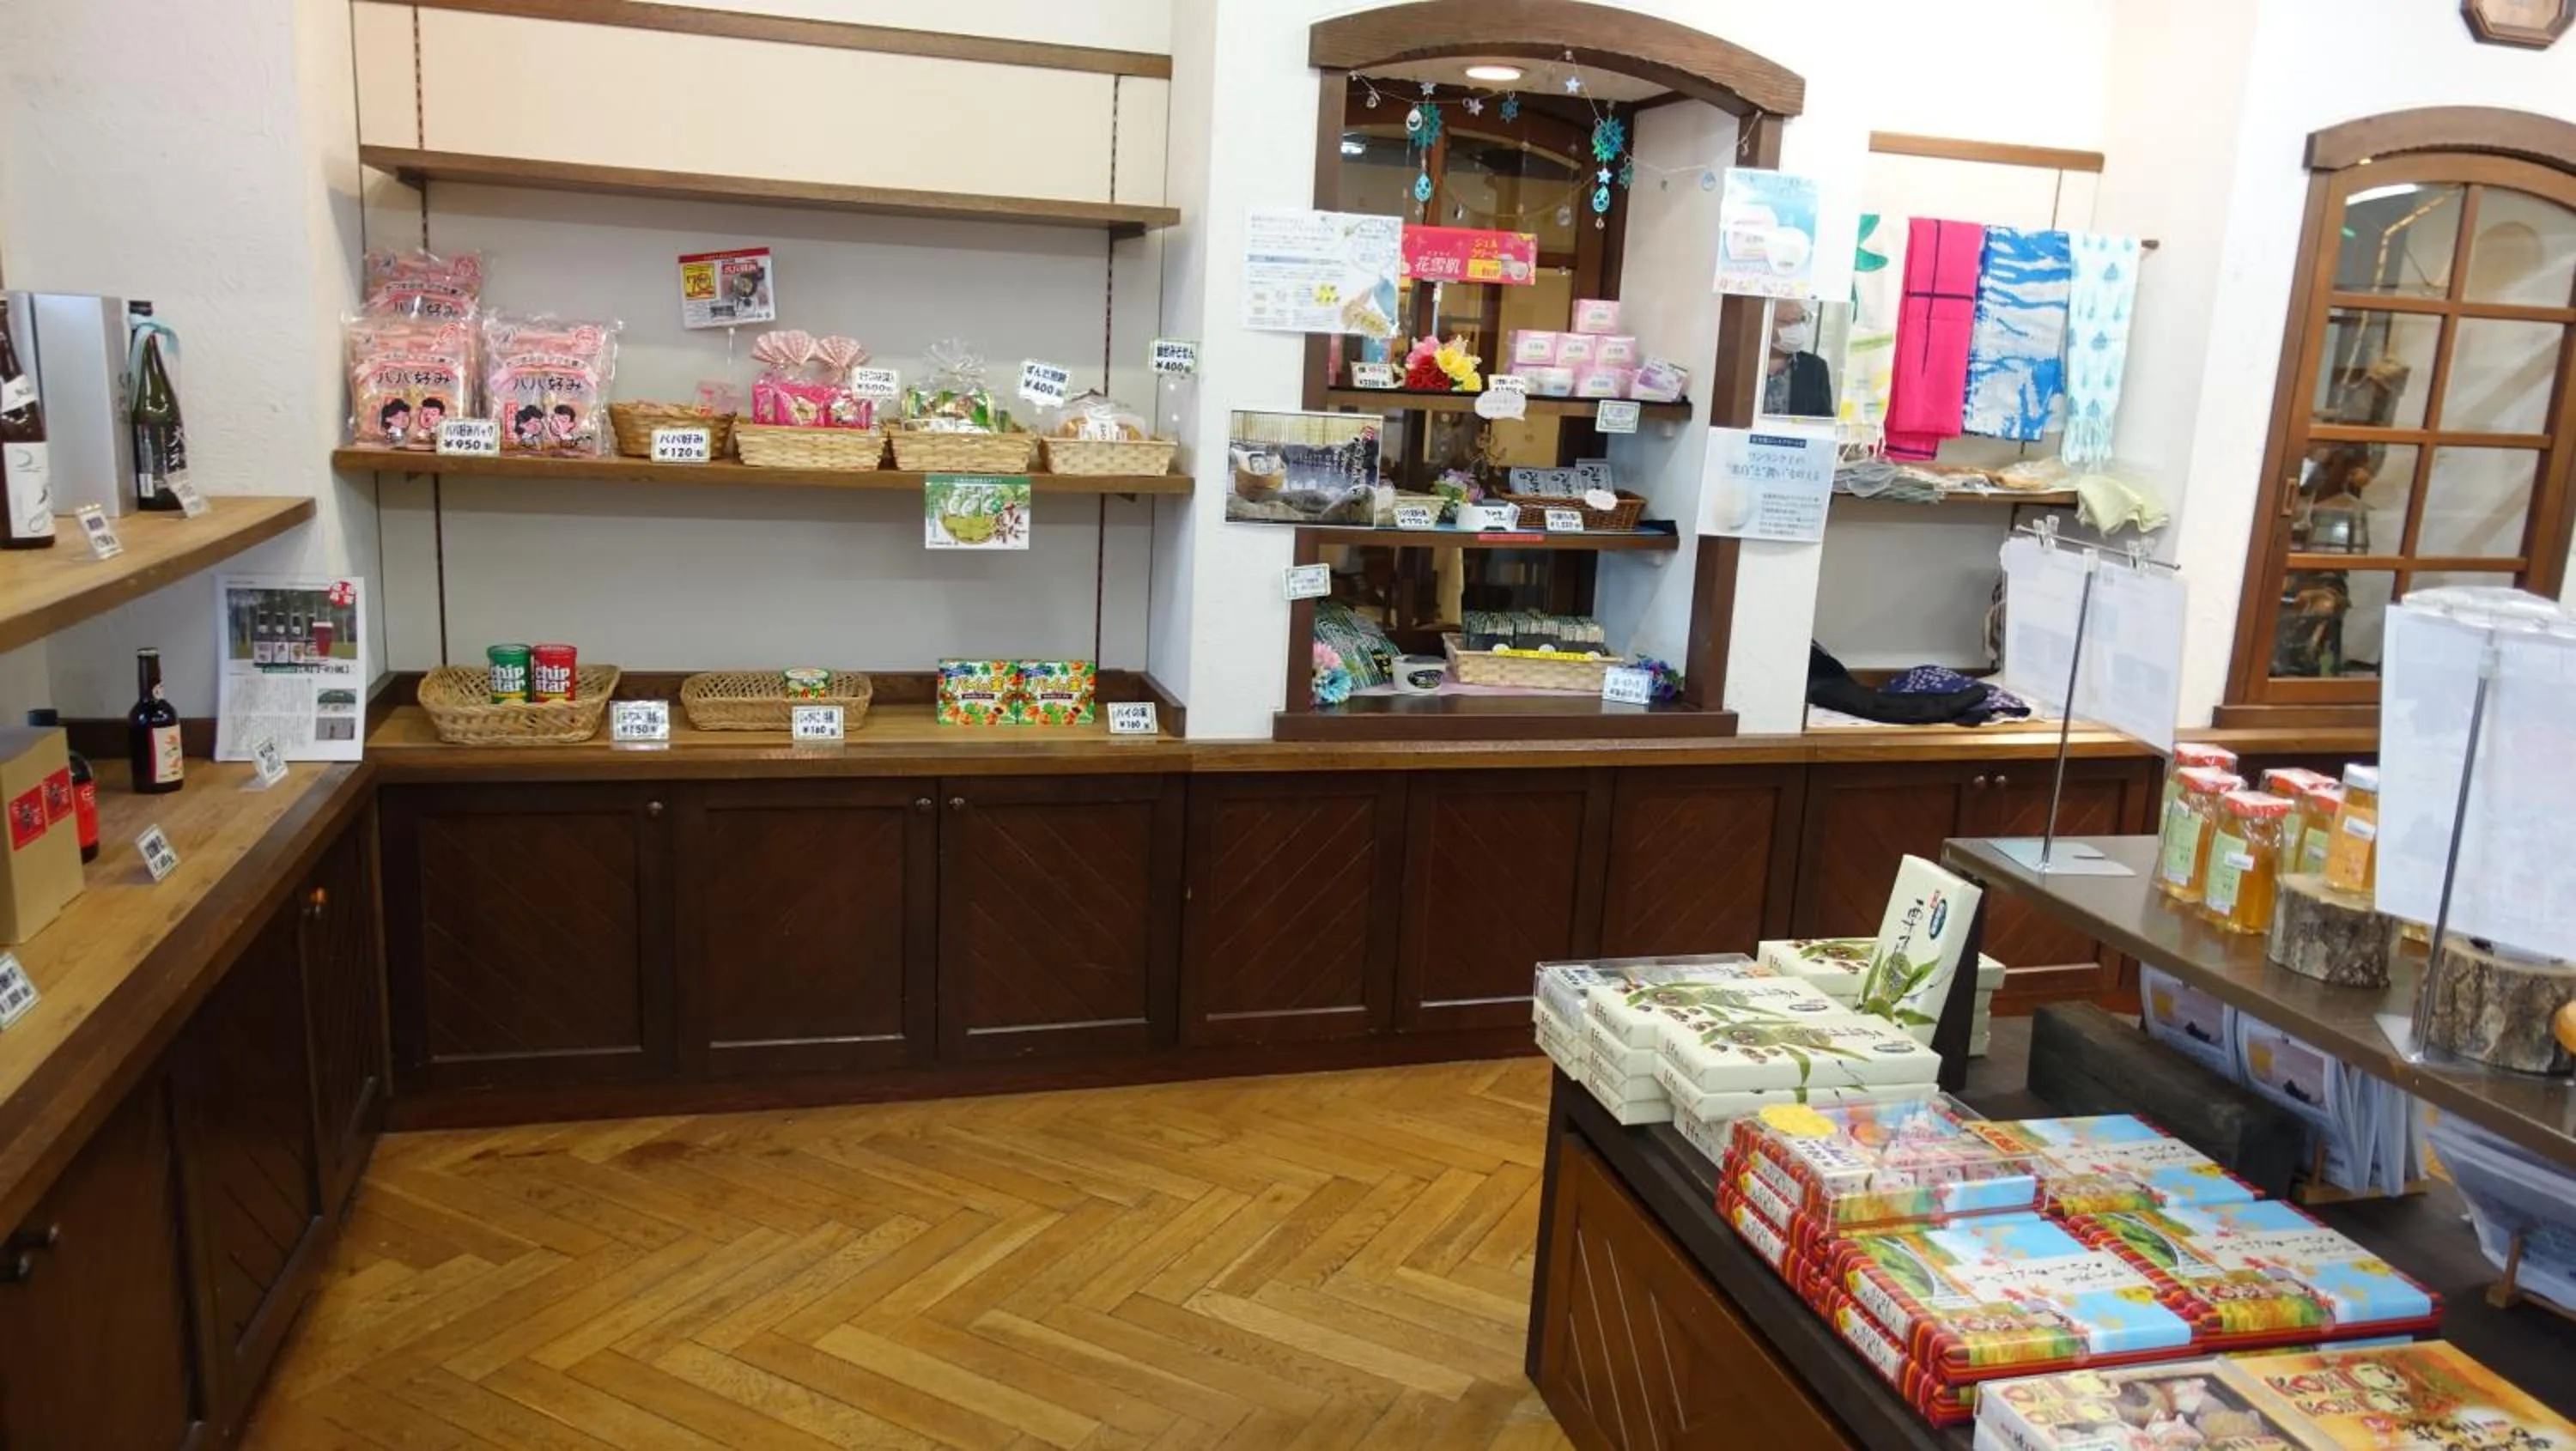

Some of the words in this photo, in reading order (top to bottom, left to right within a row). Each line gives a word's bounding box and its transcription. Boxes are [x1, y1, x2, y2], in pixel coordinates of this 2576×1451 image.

[491, 664, 525, 680] chip
[535, 664, 571, 680] chip
[491, 679, 526, 693] star
[535, 679, 570, 693] star
